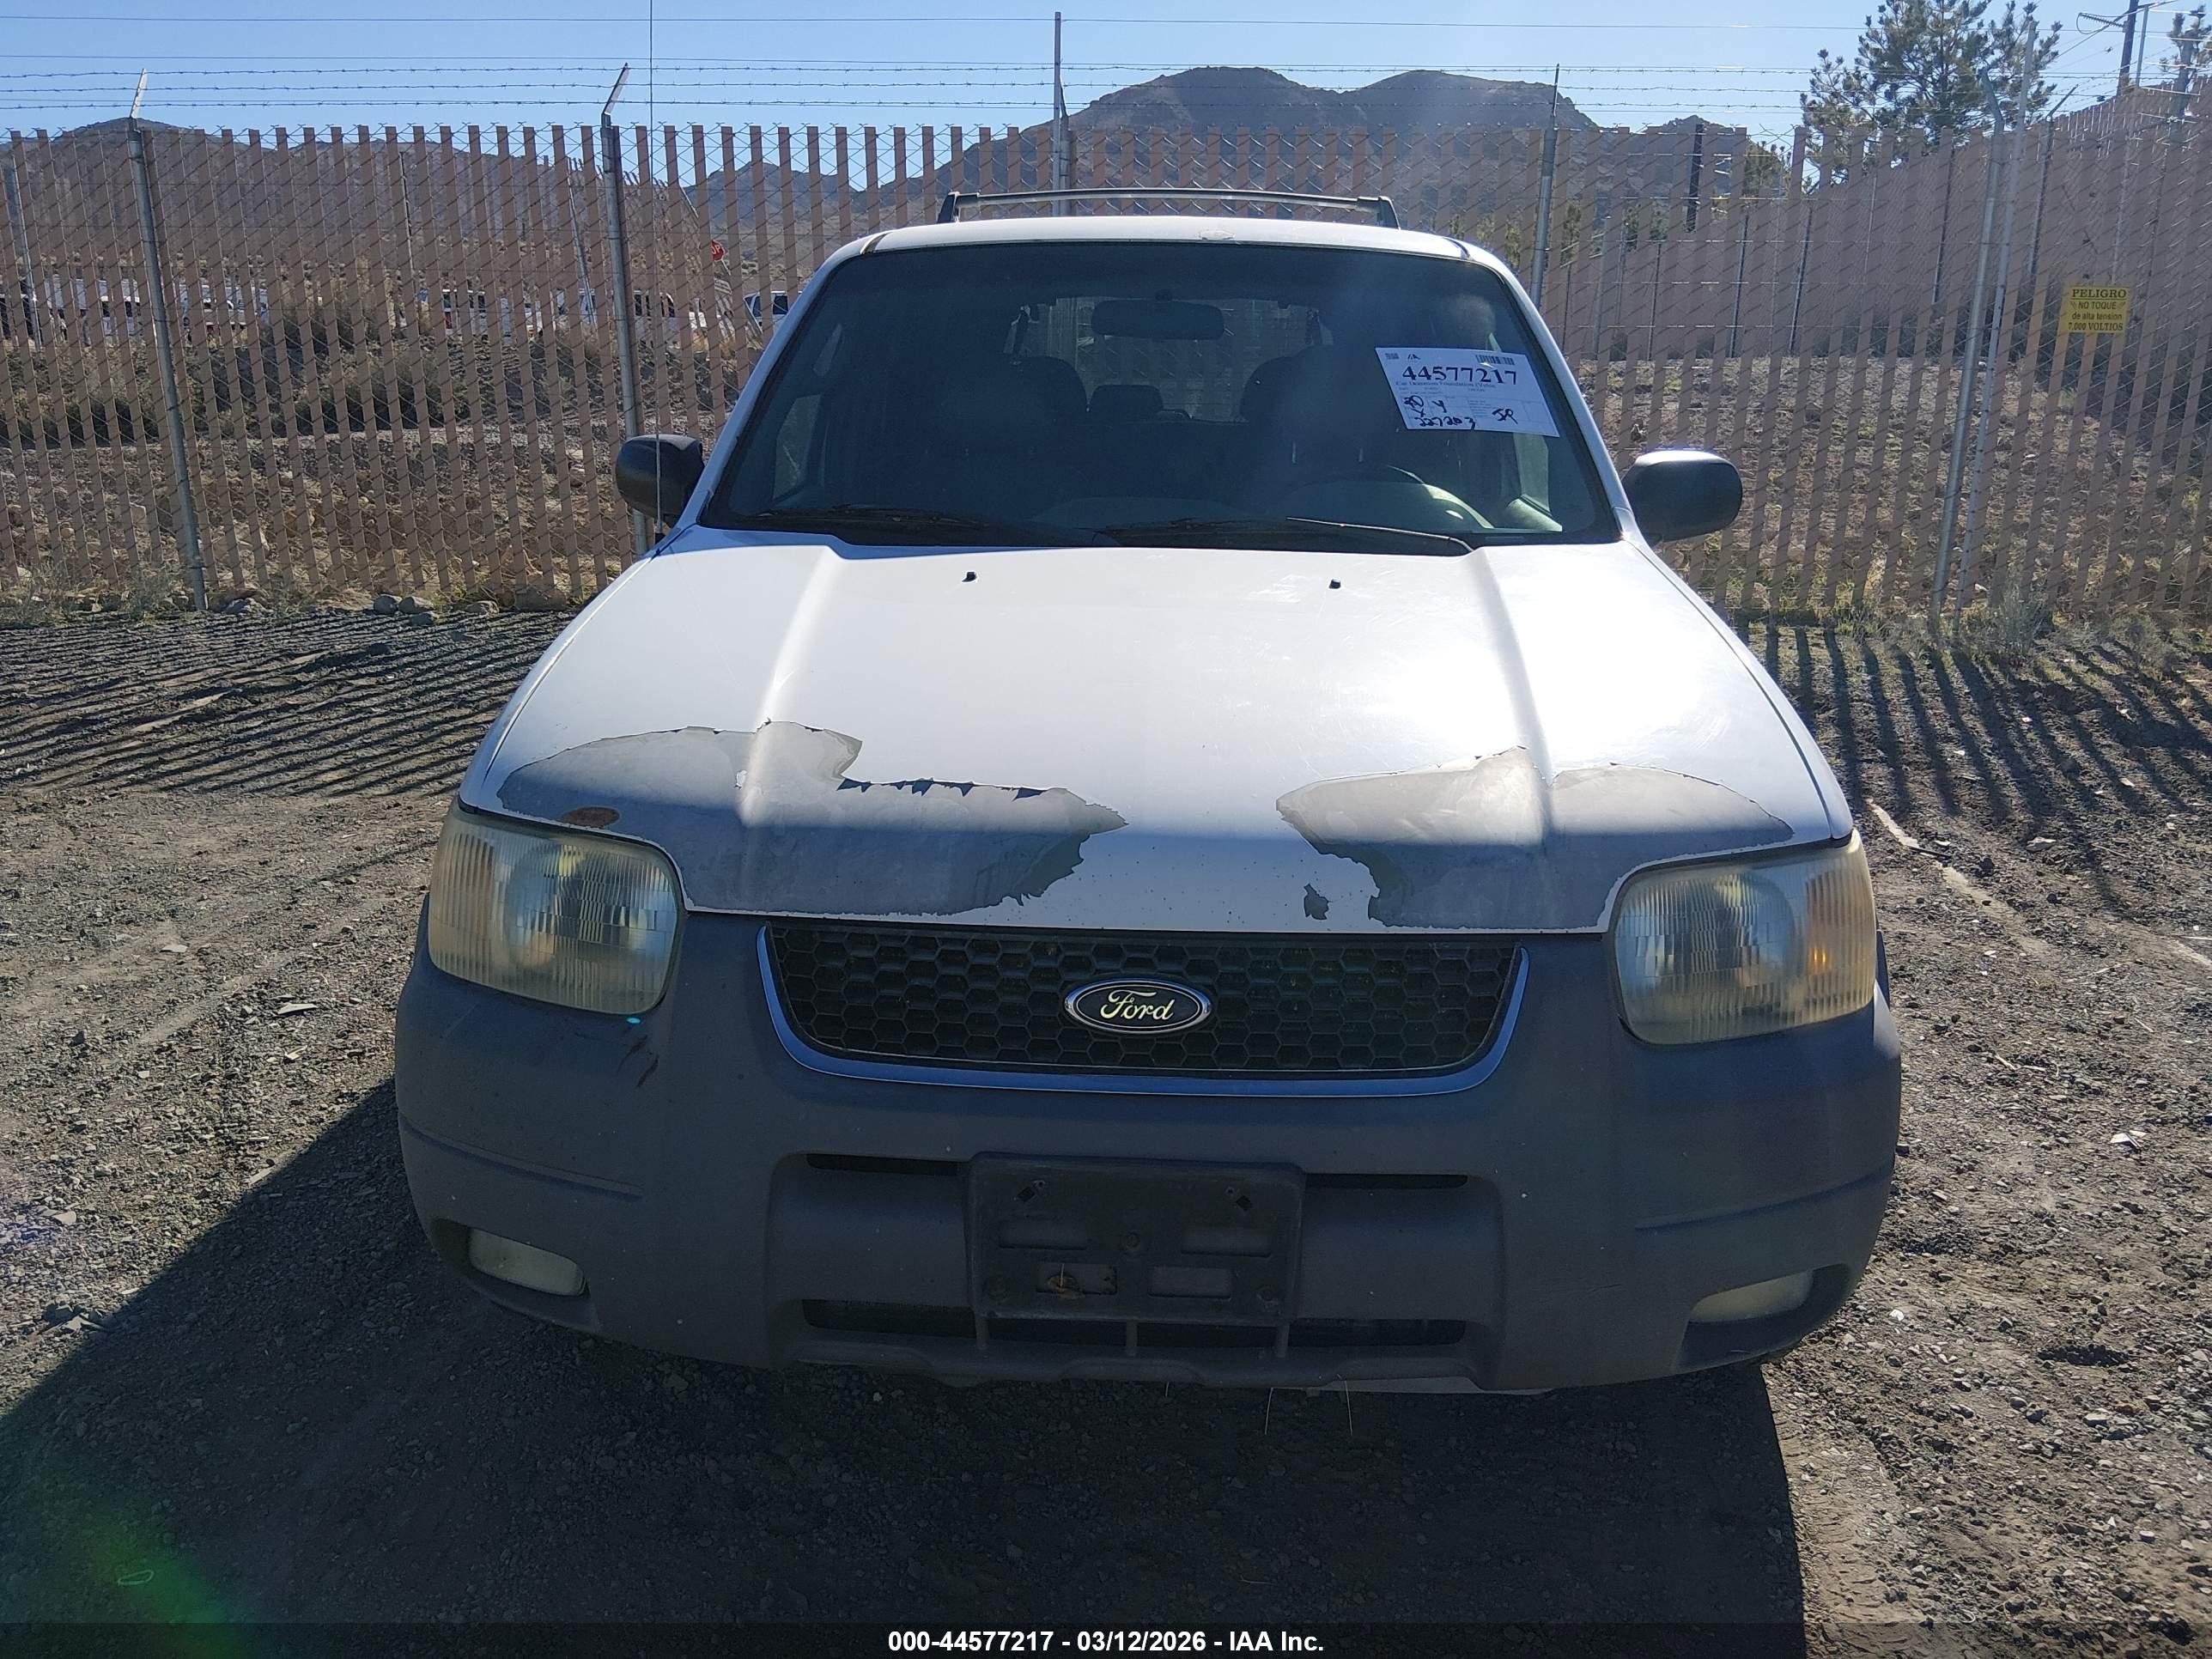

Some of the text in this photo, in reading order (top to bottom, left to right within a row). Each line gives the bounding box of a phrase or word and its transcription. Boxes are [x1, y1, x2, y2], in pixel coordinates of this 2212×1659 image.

[2072, 289, 2127, 298] PELIGRO
[2072, 312, 2081, 320] de
[2087, 322, 2124, 331] VOLTIOS
[1401, 366, 1516, 385] 44577217
[1100, 989, 1176, 1020] Ford
